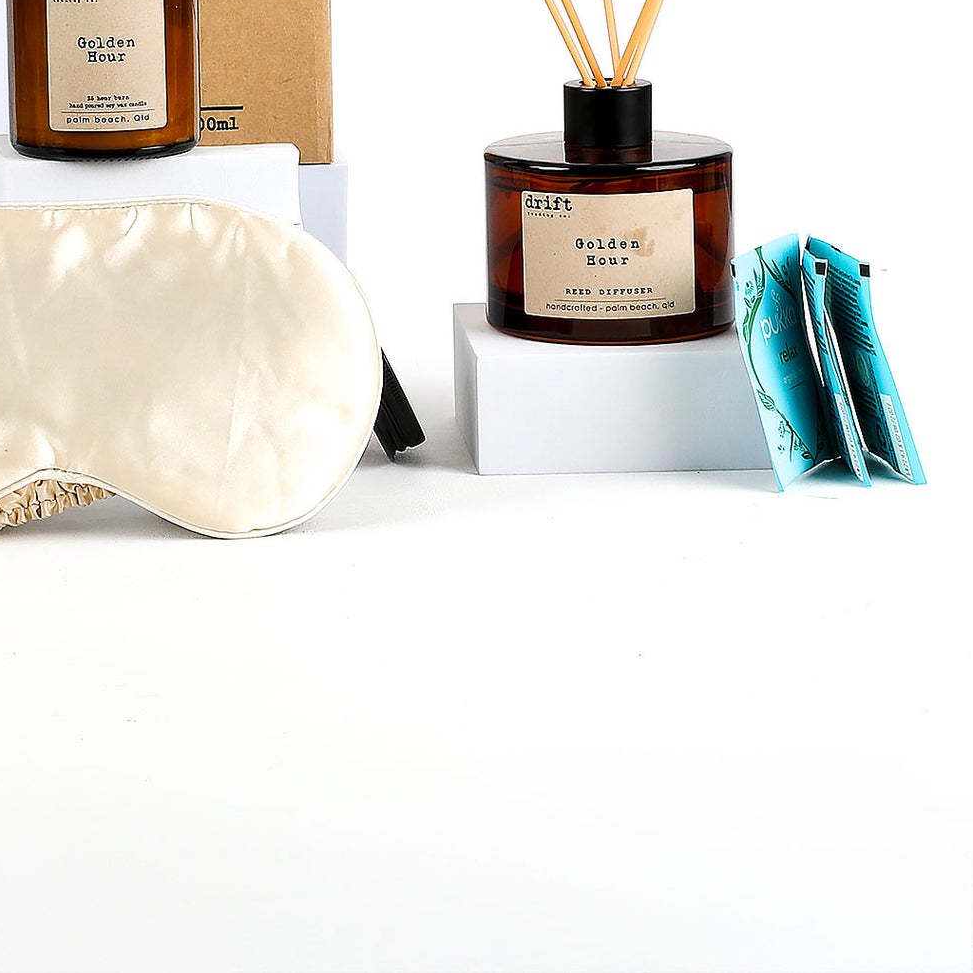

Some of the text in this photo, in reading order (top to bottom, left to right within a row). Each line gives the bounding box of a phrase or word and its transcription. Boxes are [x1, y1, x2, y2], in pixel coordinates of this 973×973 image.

[77, 36, 135, 49] Golden
[87, 50, 126, 63] Hour
[66, 116, 90, 124] palm
[133, 113, 150, 122] Qld
[525, 194, 573, 212] drift
[575, 237, 641, 250] Golden
[586, 254, 630, 266] Hour
[565, 287, 654, 296] REED DIFFUSER
[545, 302, 598, 313] handcrafted
[605, 303, 628, 313] palm
[661, 300, 675, 310] qld
